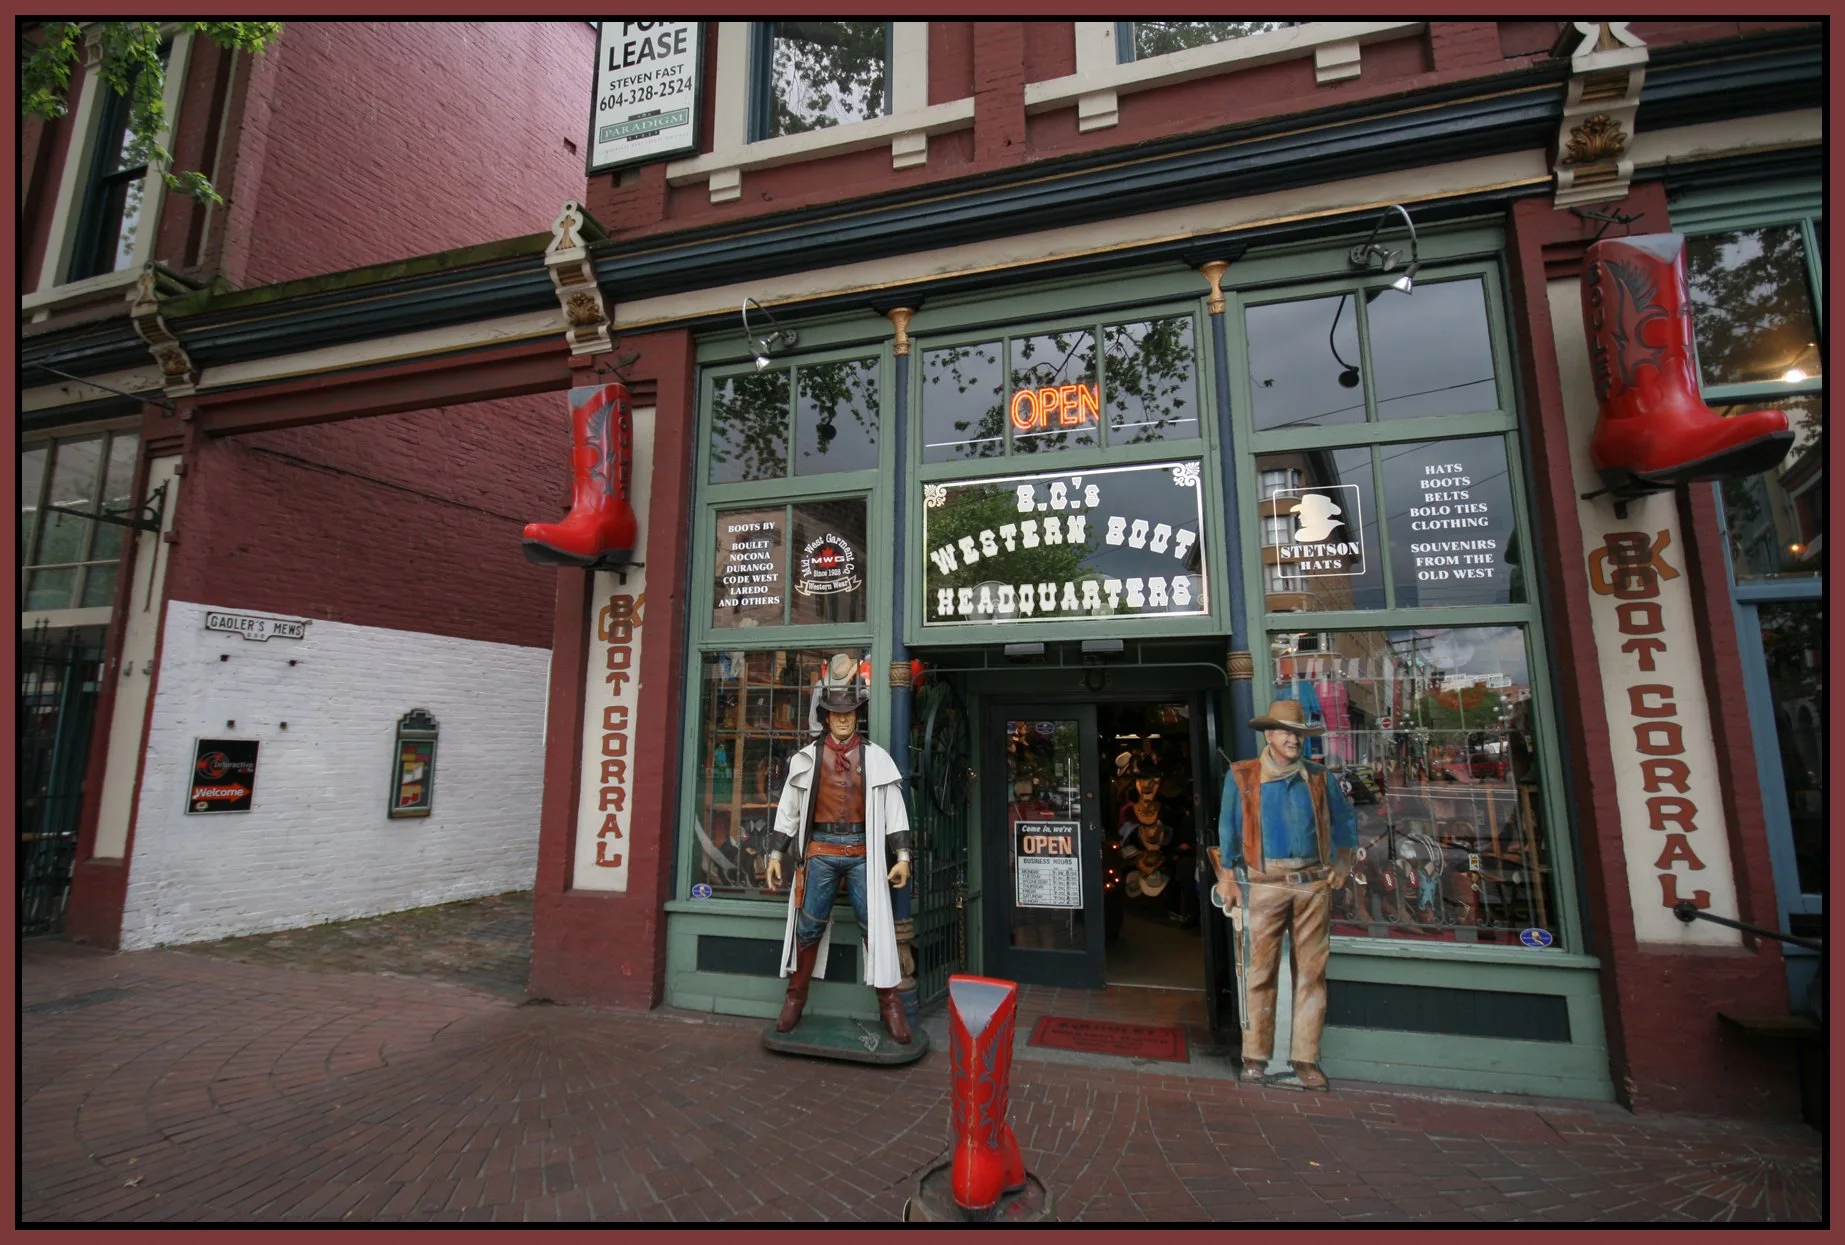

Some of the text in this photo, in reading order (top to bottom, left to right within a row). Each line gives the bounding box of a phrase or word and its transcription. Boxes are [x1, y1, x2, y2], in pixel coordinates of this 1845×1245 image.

[609, 28, 688, 71] LEASE
[609, 64, 685, 91] STEVEN FAST
[600, 76, 693, 111] 604-328-2524
[604, 113, 684, 138] PARADIGM
[1011, 383, 1100, 430] OPEN
[1425, 463, 1463, 475] HATS
[1420, 476, 1471, 489] BOOTS
[1016, 476, 1100, 512] B.C.'s
[1424, 490, 1470, 503] BELTS
[1410, 503, 1488, 517] BOLO TIES
[728, 522, 775, 533] BOOTS BY
[1411, 517, 1489, 531] CLOTHING
[731, 540, 770, 551] BOULET
[826, 533, 855, 562] Garment
[930, 515, 1197, 576] WESTERN BOOT
[1281, 542, 1360, 559] STETSON
[1411, 539, 1497, 553] SOUVENIRS
[729, 551, 771, 562] NOCONA
[811, 556, 845, 564] MWG
[1416, 554, 1495, 567] FROM THE
[726, 563, 774, 573] DURANGO
[1300, 560, 1342, 570] HATS
[723, 573, 779, 584] CODE WEST
[813, 569, 828, 577] Since
[1418, 568, 1495, 581] OLD WEST
[730, 585, 768, 595] LAREDO
[808, 580, 849, 590] Western Wear
[719, 596, 780, 607] AND OTHERS
[937, 575, 1192, 616] HEADQUARTERS
[1602, 531, 1668, 672] BOOT
[273, 623, 302, 637] MEWS
[605, 594, 635, 697] BOOT
[194, 787, 245, 798] Welcome
[595, 705, 629, 868] CORRAL
[1626, 684, 1711, 910] CORRAL
[1022, 825, 1041, 833] Come
[1053, 825, 1072, 833] we're
[1023, 835, 1072, 855] OPEN
